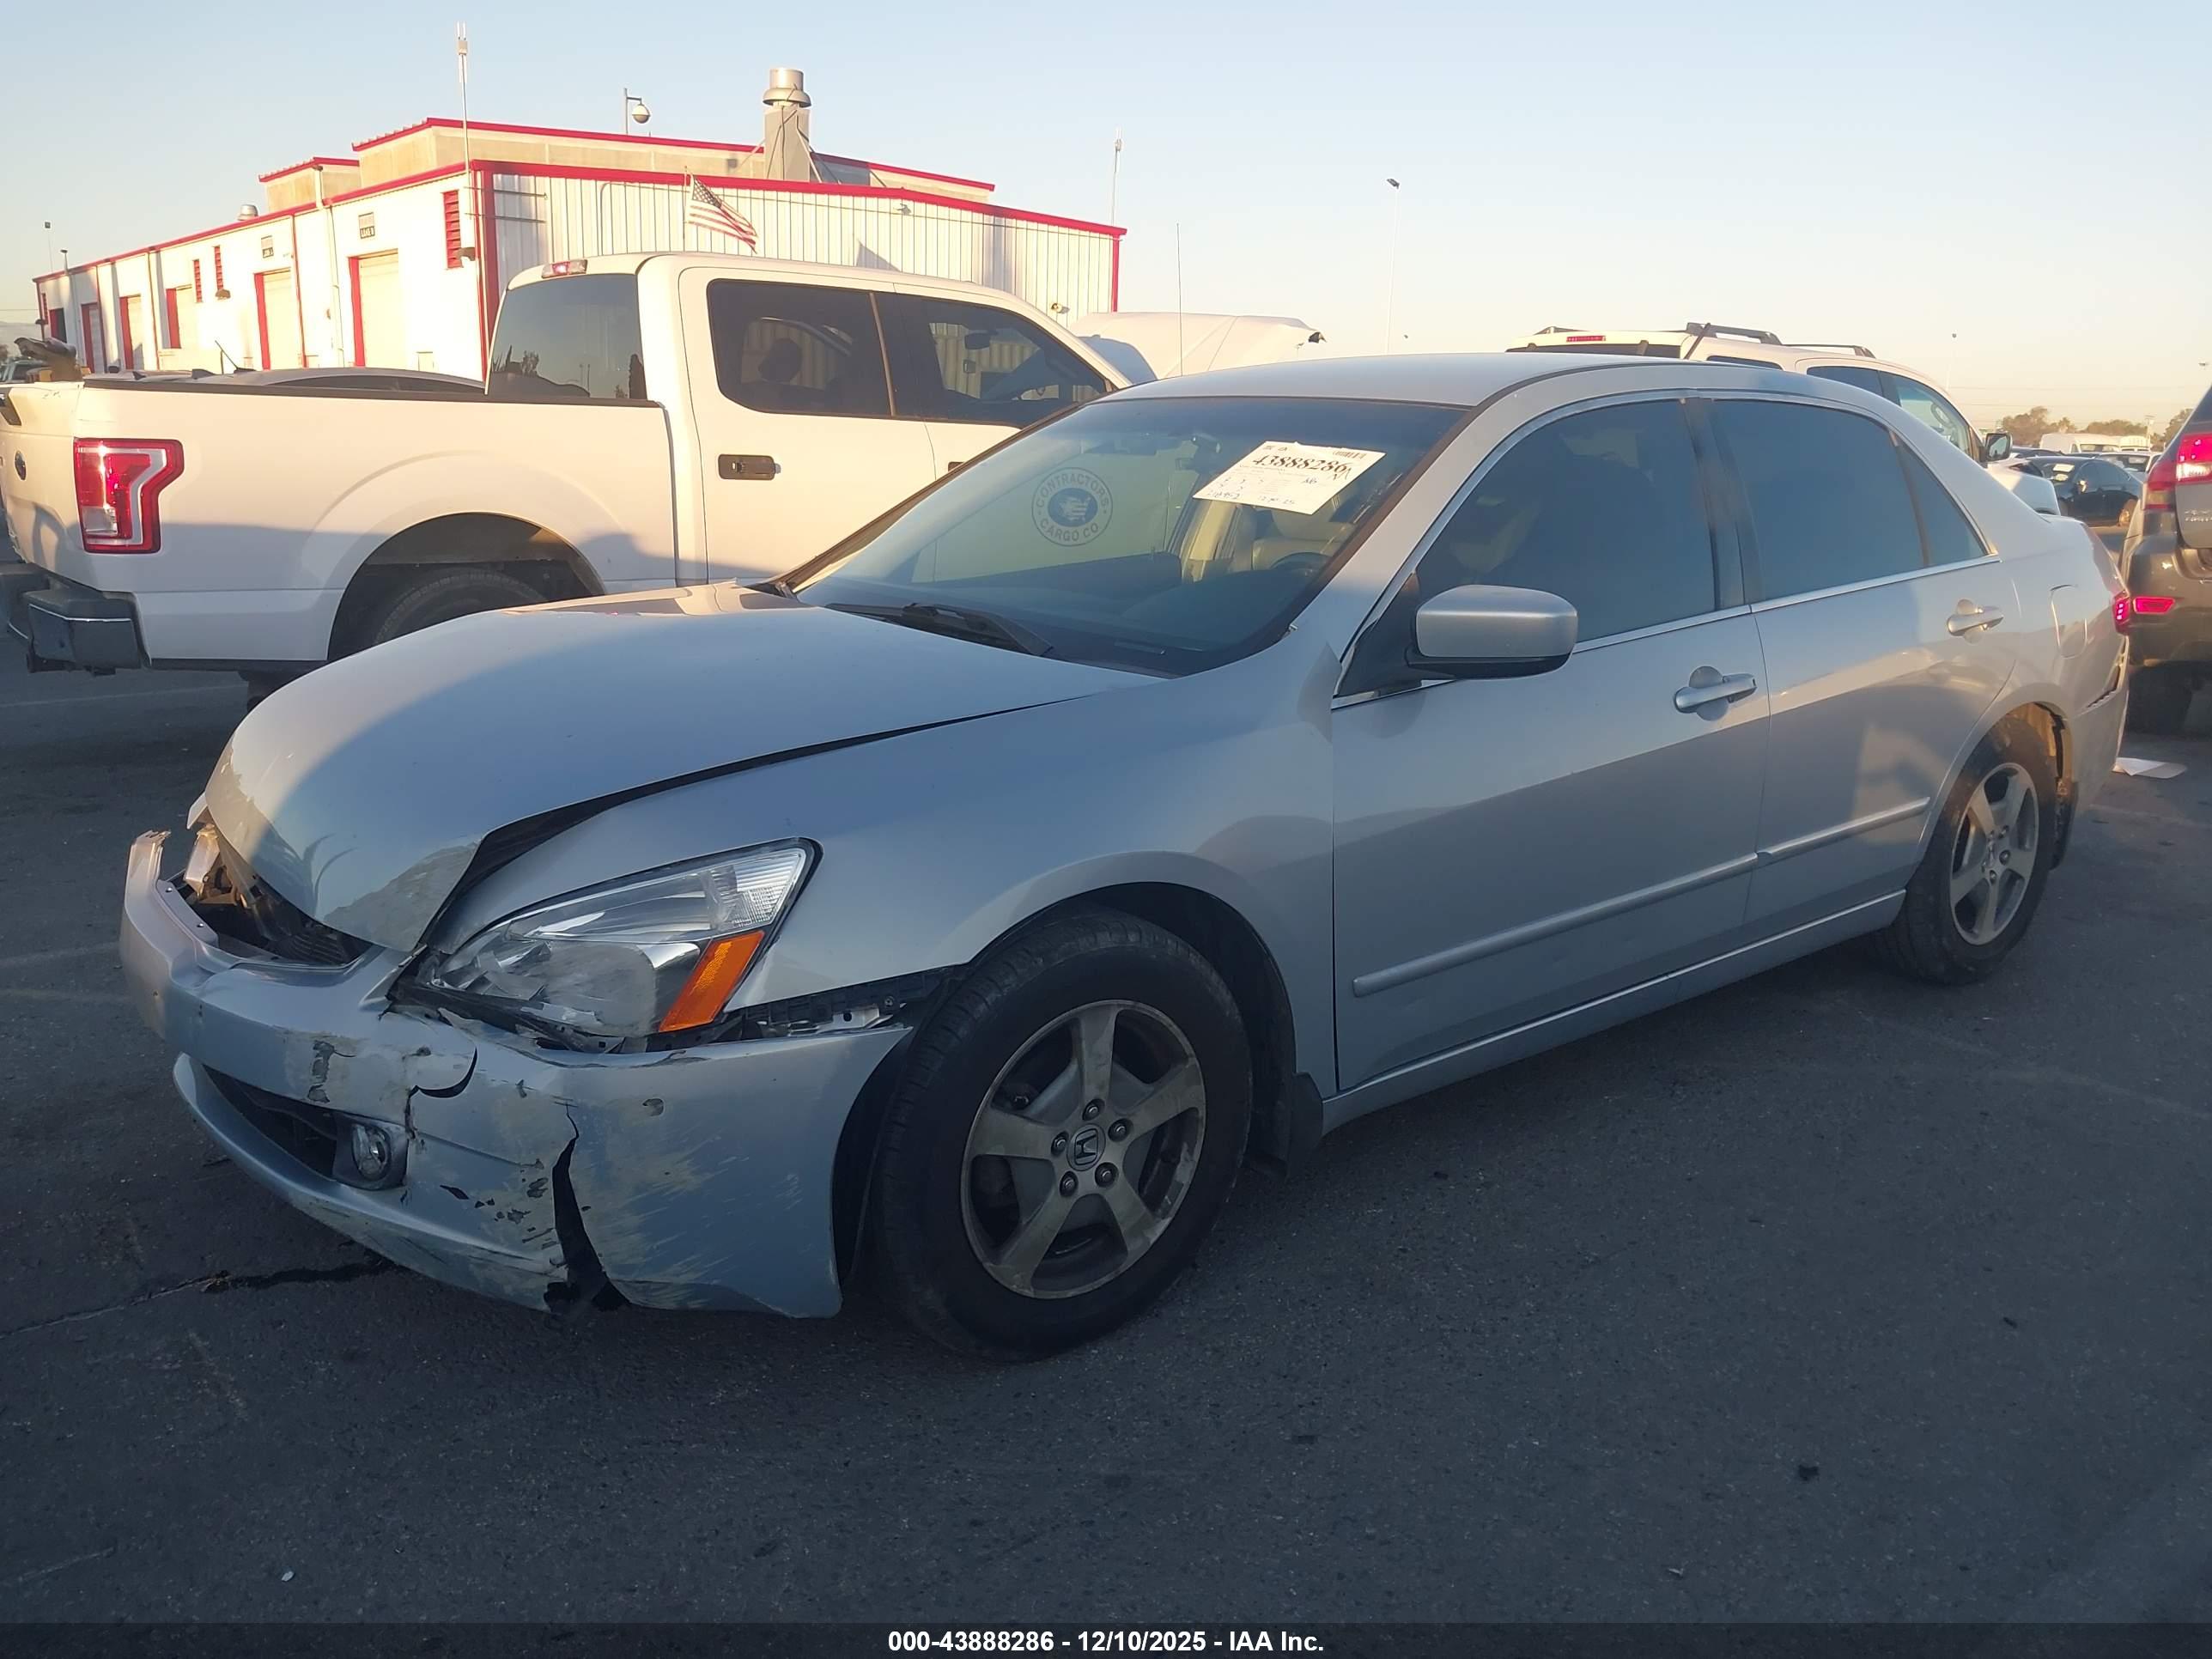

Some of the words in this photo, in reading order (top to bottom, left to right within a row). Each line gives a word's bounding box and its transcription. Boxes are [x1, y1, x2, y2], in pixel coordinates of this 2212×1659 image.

[1252, 455, 1350, 474] 43888286
[1036, 473, 1109, 507] CONTRACTORS
[1040, 518, 1079, 542] CARGO
[1083, 522, 1099, 538] CO
